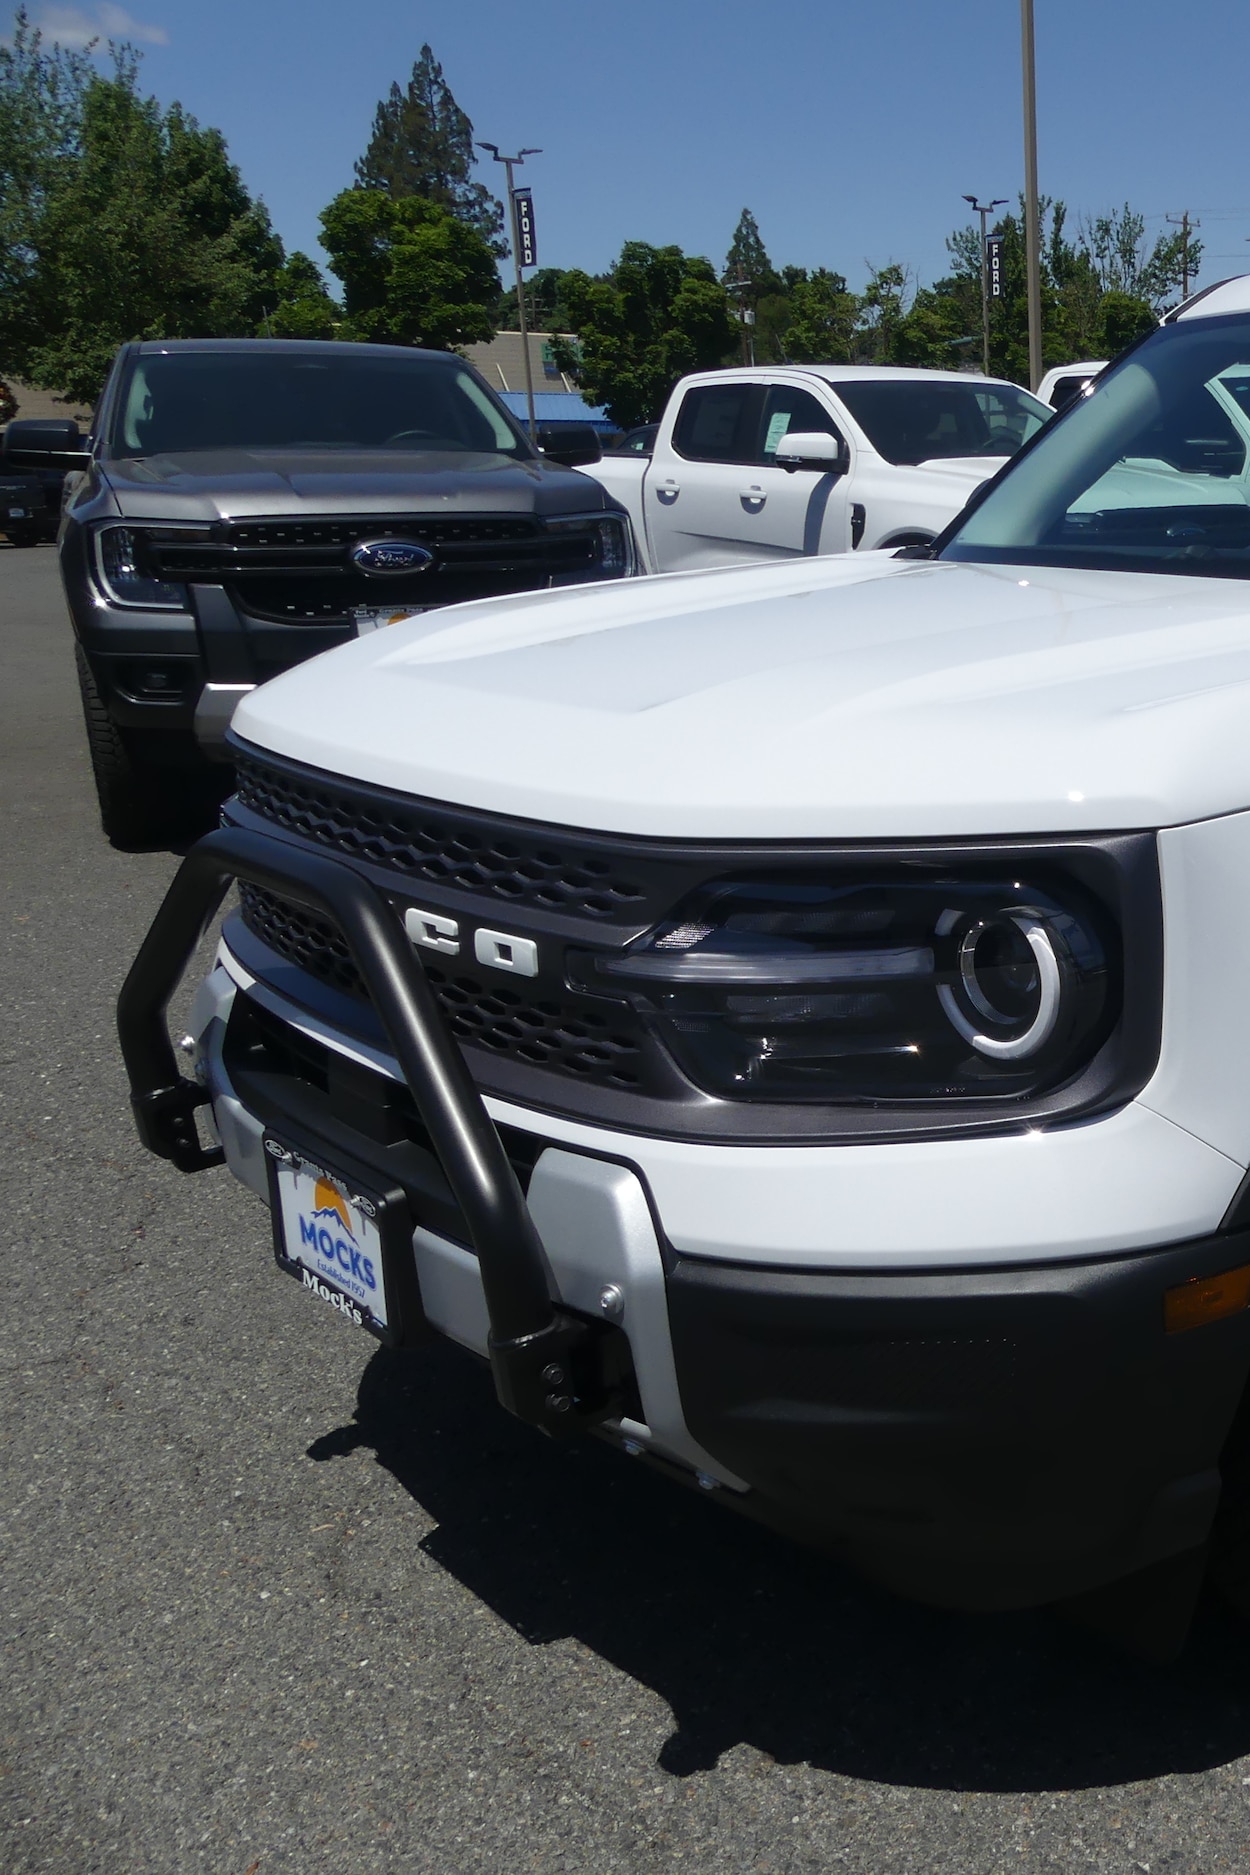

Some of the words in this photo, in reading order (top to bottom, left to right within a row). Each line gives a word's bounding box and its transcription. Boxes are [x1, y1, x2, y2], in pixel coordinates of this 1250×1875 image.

[521, 201, 532, 264] FORD
[992, 244, 1000, 296] FORD
[299, 1213, 377, 1292] MOCKS
[317, 1259, 351, 1289] Established
[351, 1280, 365, 1298] 1957
[302, 1268, 363, 1325] Mock's
